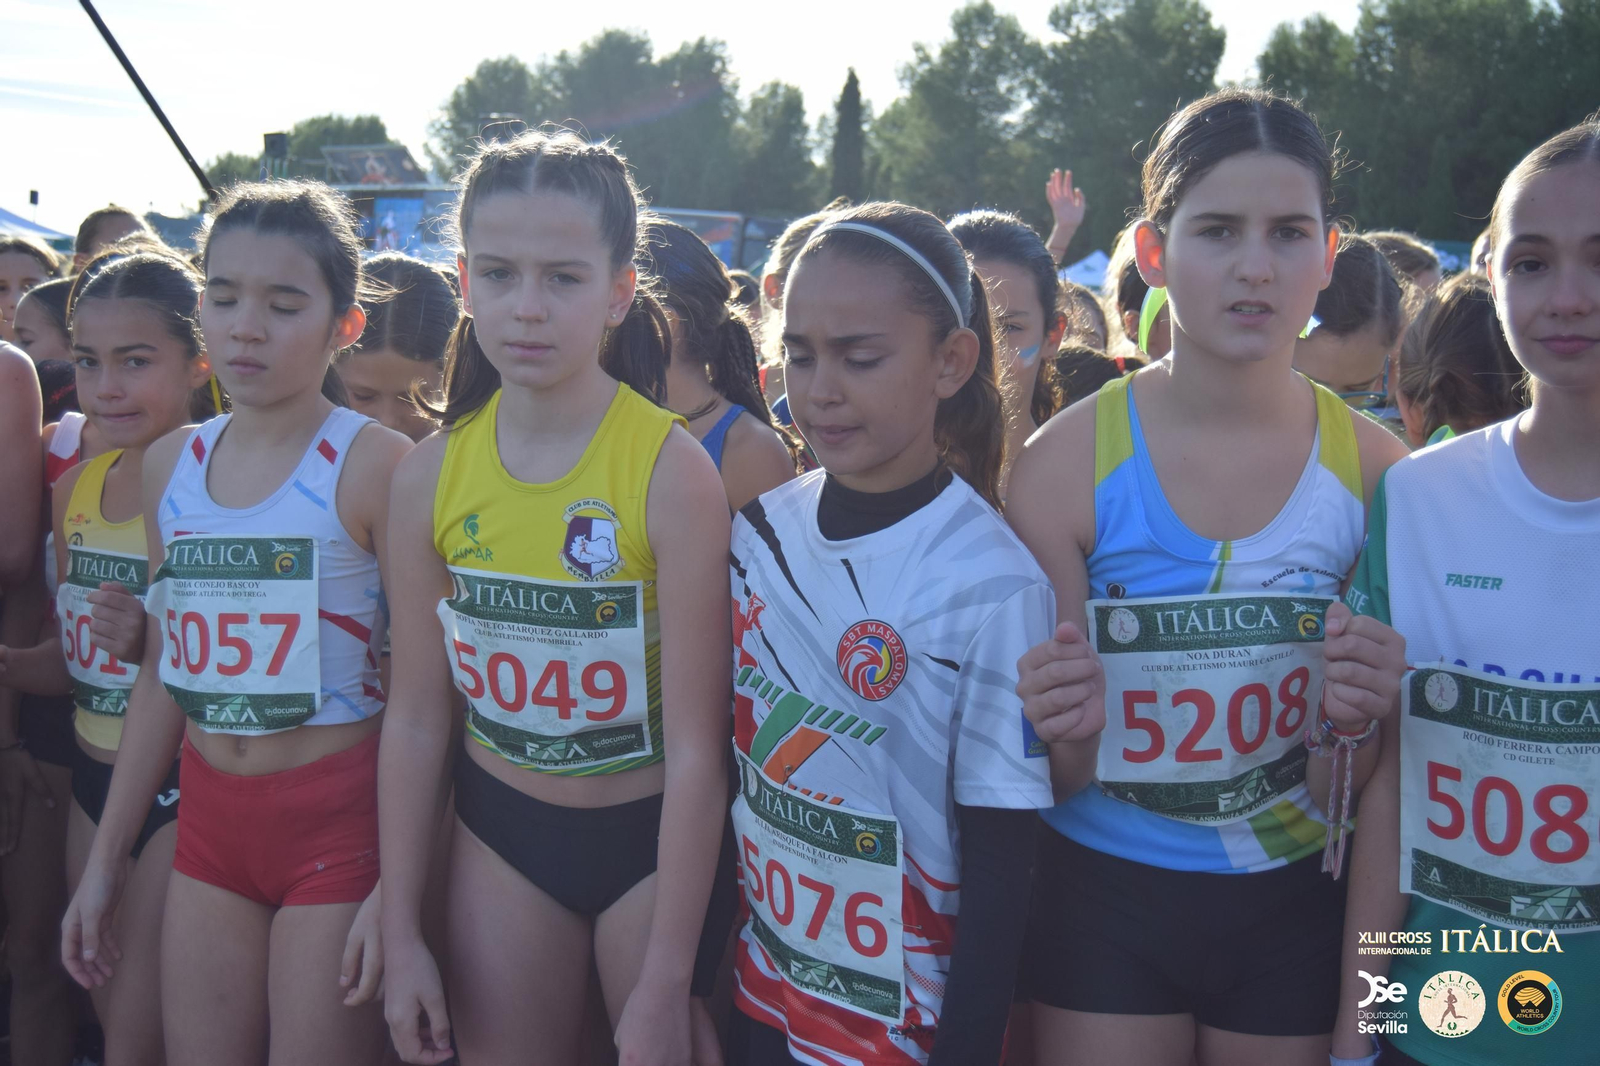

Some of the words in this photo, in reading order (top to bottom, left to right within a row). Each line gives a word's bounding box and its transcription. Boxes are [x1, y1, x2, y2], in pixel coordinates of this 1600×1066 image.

[568, 503, 582, 513] CLUB
[171, 540, 260, 566] ITÁLICA
[78, 554, 140, 583] ITÁLICA
[1261, 567, 1296, 589] Escuela
[194, 580, 226, 589] CONEJO
[227, 581, 261, 590] BASCOY
[1445, 573, 1504, 591] FASTER
[199, 589, 231, 598] ATLÉTICA
[475, 582, 578, 615] ITÁLICA
[476, 606, 526, 616] INTERNATIONAL
[548, 613, 579, 621] COUNTRY
[1155, 603, 1280, 635] ITÁLICA
[166, 608, 301, 677] 5057
[474, 628, 493, 637] CLUB
[493, 632, 535, 643] ATLETISMO
[536, 637, 583, 647] MEMBRILLA
[554, 630, 609, 639] GALLARDO
[1159, 633, 1217, 642] INTERNATIONAL
[1244, 628, 1281, 636] COUNTRY
[843, 627, 861, 649] SBT
[867, 624, 904, 695] MASPALOMAS
[1141, 664, 1161, 672] CLUB
[1163, 664, 1175, 672] DE
[1175, 661, 1227, 672] ATLETISMO
[1228, 659, 1258, 669] MAURI
[1259, 649, 1295, 666] CASTILLO
[1186, 652, 1210, 661] NOA
[1212, 648, 1251, 660] DURAN
[453, 638, 628, 722] 5049
[273, 706, 308, 715] docunova
[1122, 666, 1310, 764] 5208
[1473, 687, 1600, 727] ITÁLICA
[1473, 713, 1529, 731] INTERNATIONAL
[1532, 726, 1560, 734] CROSS
[600, 734, 636, 746] docunova
[1497, 738, 1552, 755] FERRERA
[559, 757, 595, 767] ATLETISMO
[1503, 753, 1517, 761] CD
[1518, 756, 1556, 766] GILETE
[760, 784, 840, 840] ITÁLICA
[1199, 811, 1240, 823] ANDALUZA
[1427, 760, 1600, 865] 508
[771, 829, 812, 854] ARISQUETA
[812, 847, 848, 865] FALCON
[772, 838, 819, 865] INDEPENDIENTE
[742, 833, 888, 958] 5076
[1448, 898, 1488, 918] FEDERACIÓN
[1490, 914, 1535, 930] ANDALUZA
[1552, 920, 1599, 931] ATLETISMO
[818, 989, 852, 1004] ATLETISMO
[858, 985, 893, 1000] docunova
